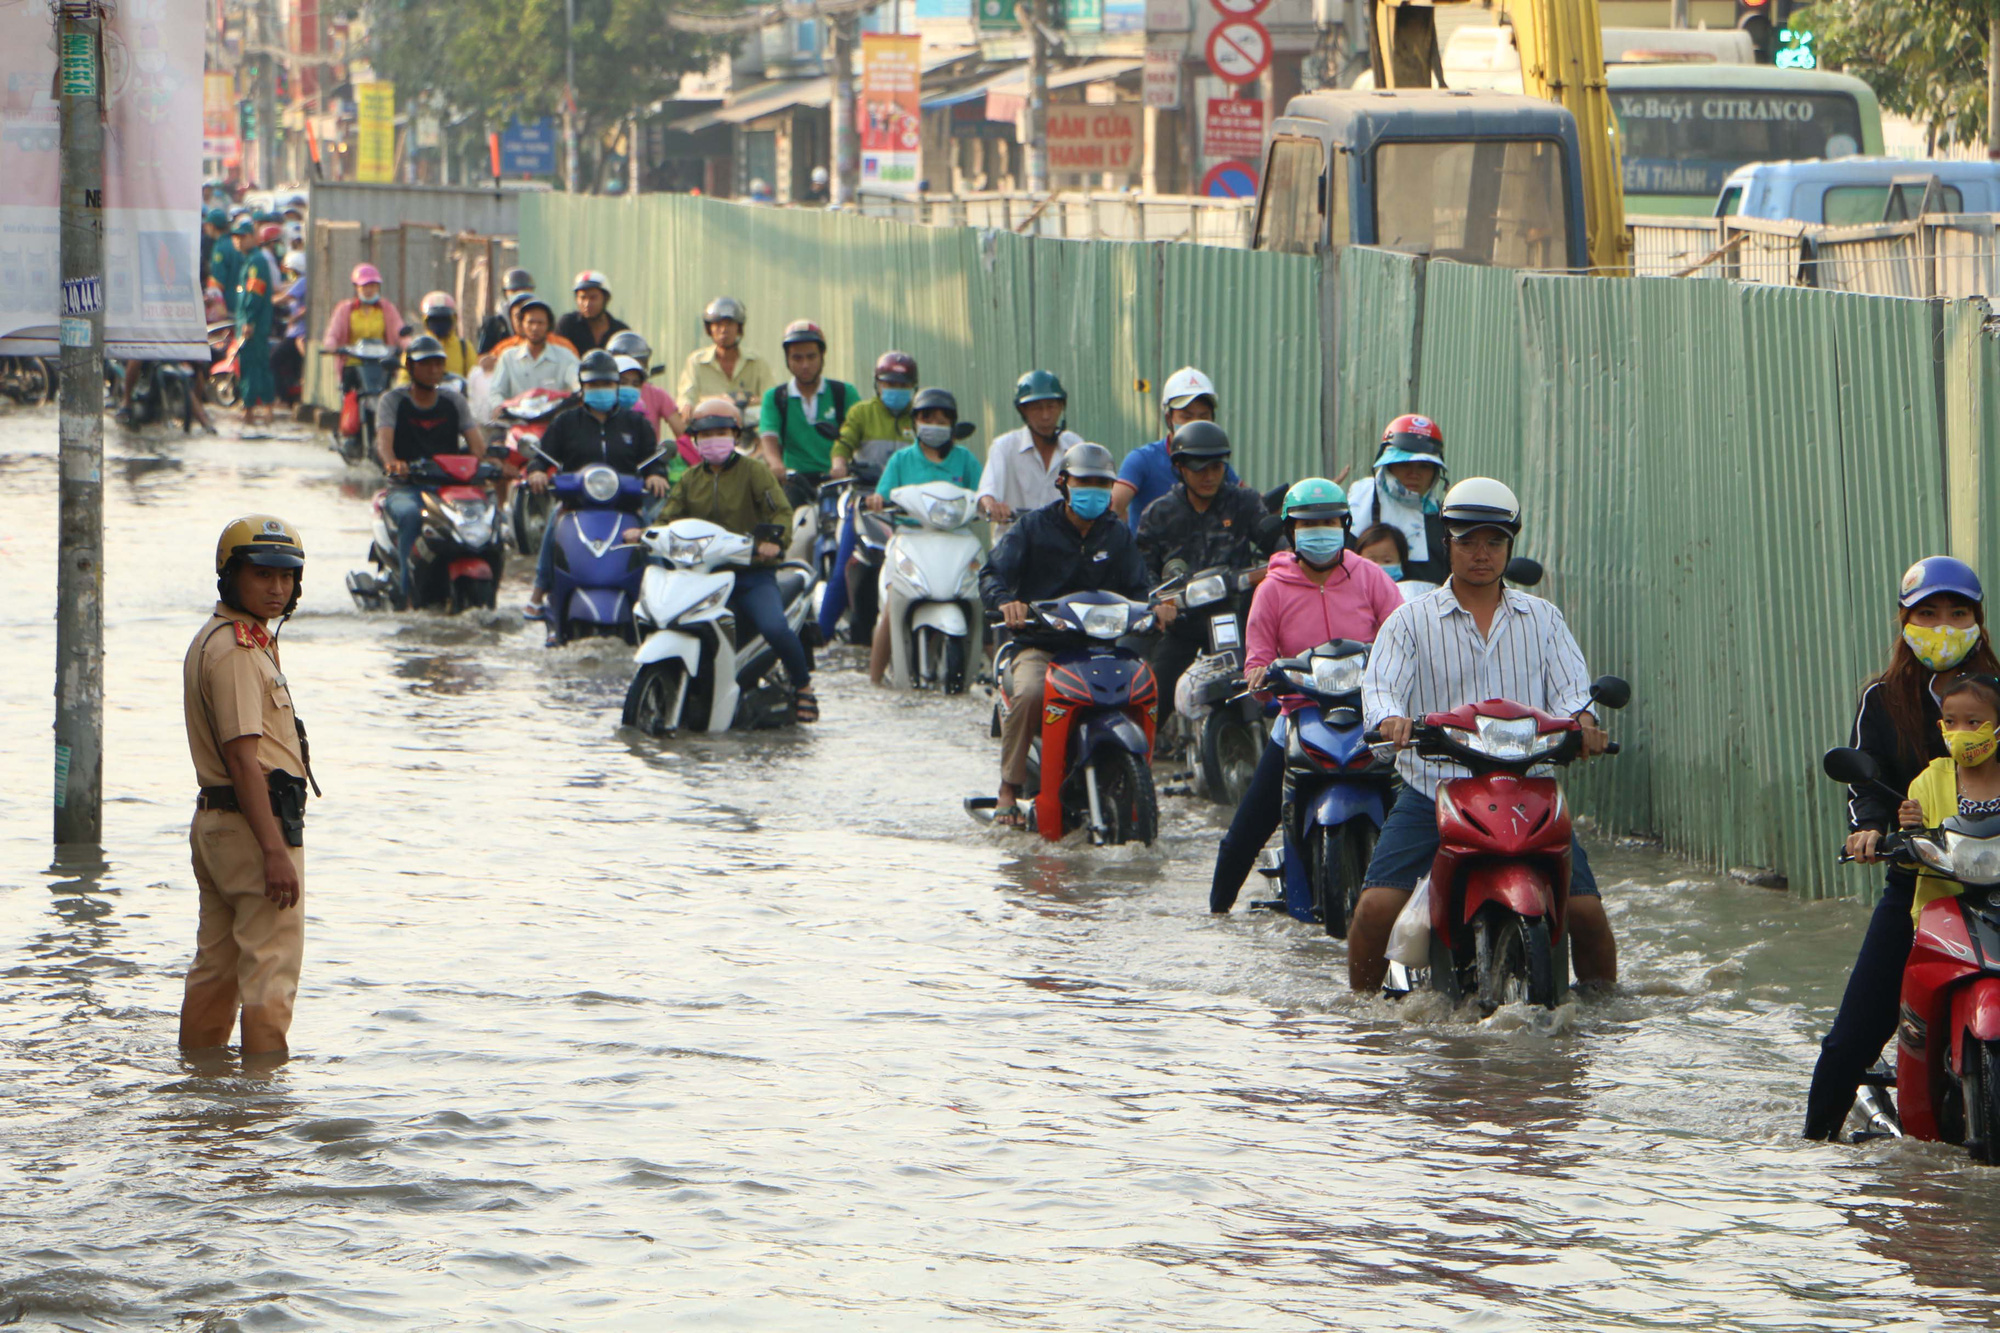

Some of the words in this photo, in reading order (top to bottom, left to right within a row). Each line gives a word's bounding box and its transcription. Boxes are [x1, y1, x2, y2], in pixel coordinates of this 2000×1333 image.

[1093, 108, 1132, 138] CỬA
[1702, 101, 1813, 122] CITRANCO
[1109, 141, 1132, 167] LÝ
[1489, 775, 1518, 784] HONDA
